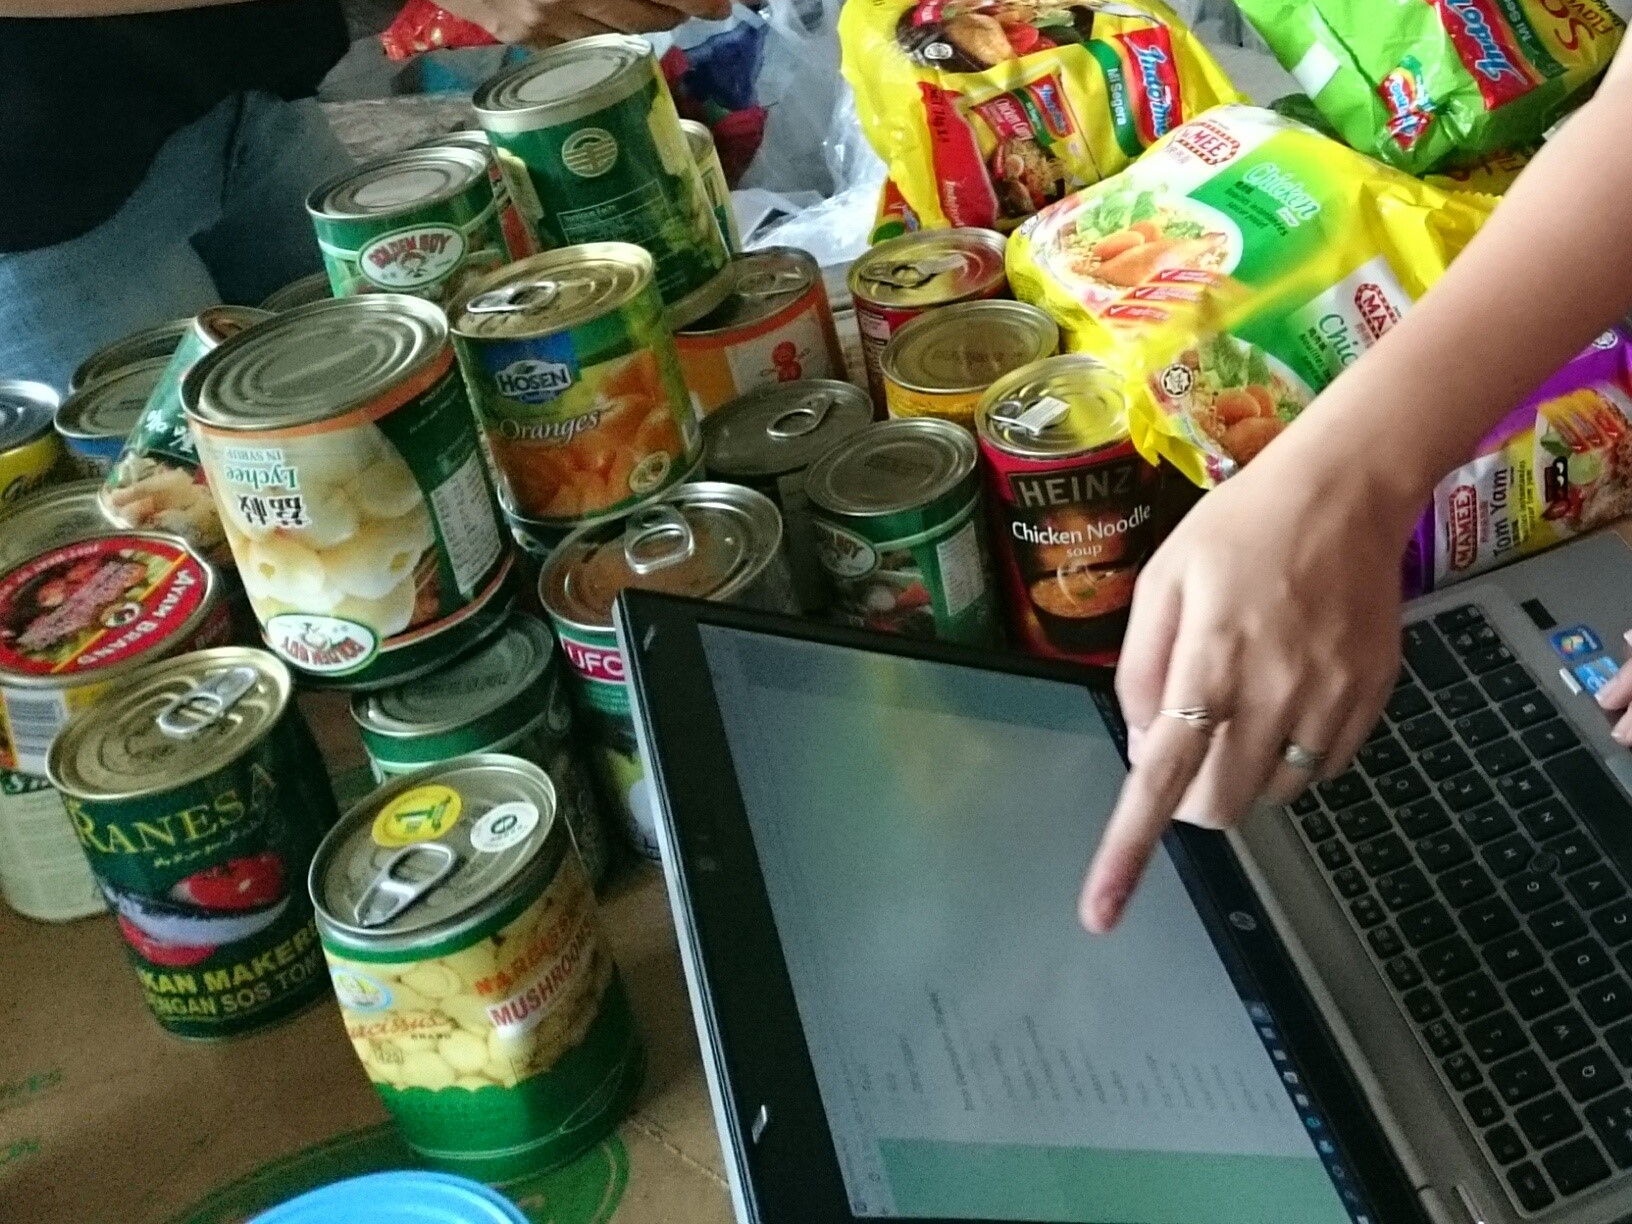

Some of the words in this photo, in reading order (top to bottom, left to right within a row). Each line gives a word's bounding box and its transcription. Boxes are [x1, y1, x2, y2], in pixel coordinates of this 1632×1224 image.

[1124, 36, 1170, 138] Indomie
[1245, 163, 1319, 217] Chicken
[420, 233, 453, 255] BOY
[500, 368, 568, 393] HOSEN
[499, 410, 601, 444] Oranges
[226, 464, 297, 490] Lychee
[1018, 465, 1134, 509] HEINZ
[1489, 468, 1508, 515] Yam
[237, 494, 304, 526] 荔枝
[1012, 521, 1083, 546] Chicken
[1087, 504, 1151, 539] Noodle
[1456, 494, 1473, 565] MAMEE
[1066, 544, 1103, 560] soup
[1492, 518, 1512, 558] Tom
[152, 568, 197, 618] AYAM
[77, 619, 158, 667] BRAND
[566, 644, 625, 677] UFC
[221, 980, 272, 1014] SOS
